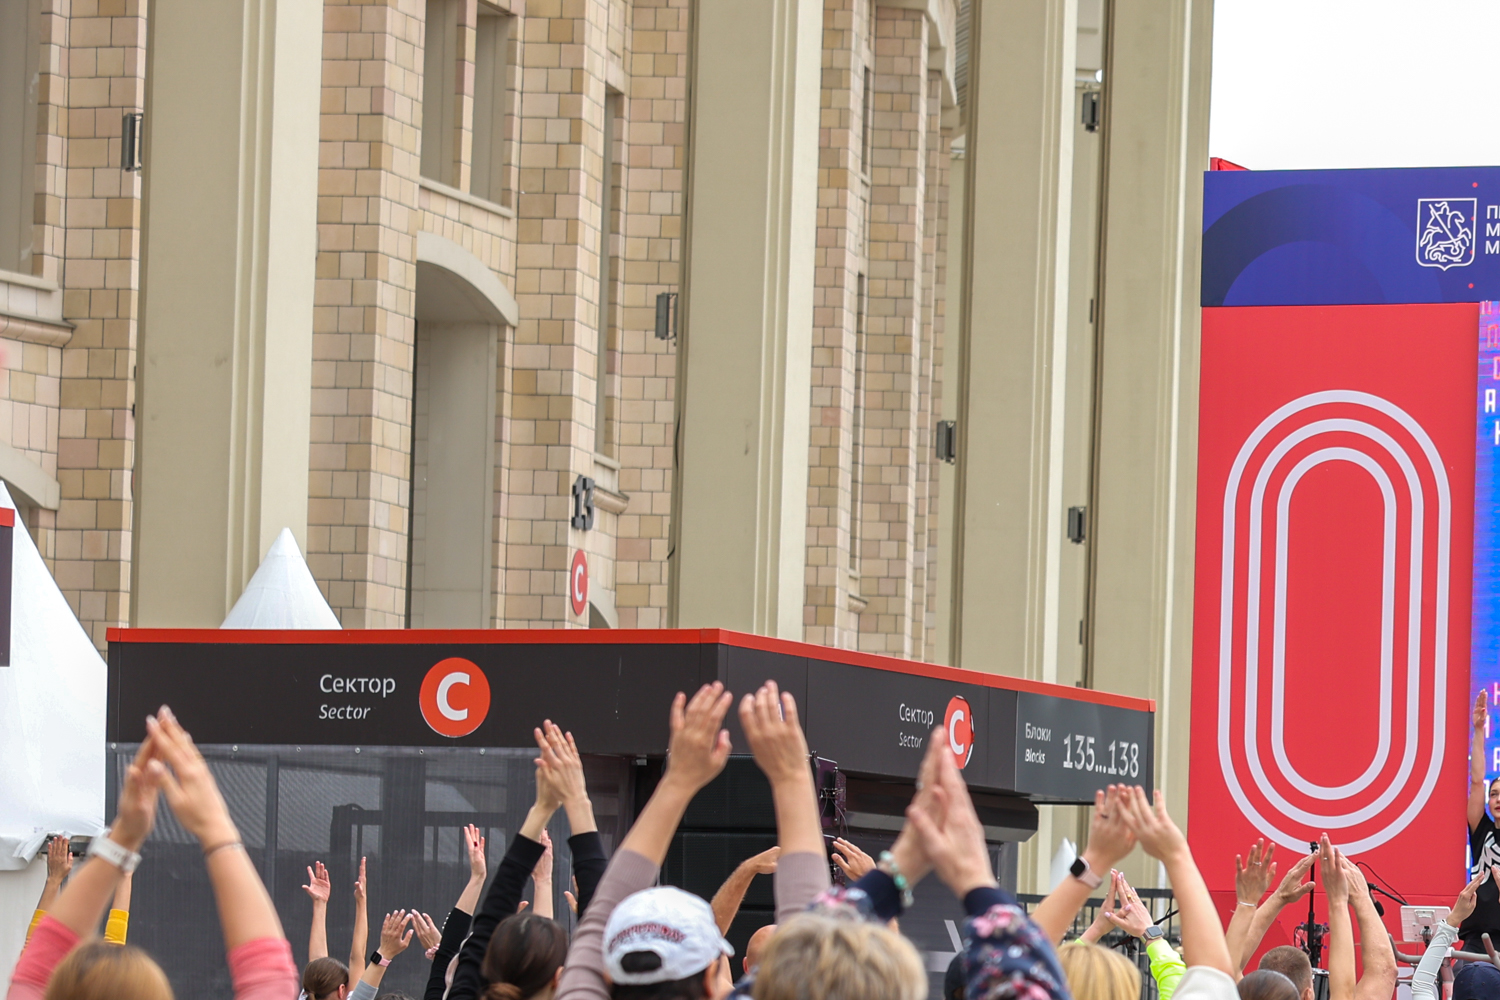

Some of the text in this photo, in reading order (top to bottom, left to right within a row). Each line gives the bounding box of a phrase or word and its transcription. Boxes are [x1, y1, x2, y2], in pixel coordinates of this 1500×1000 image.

[571, 474, 595, 531] 13
[319, 674, 396, 699] Сектор
[318, 704, 371, 720] Sector
[899, 703, 934, 729] Сектор
[898, 731, 923, 749] Sector
[1025, 722, 1052, 742] Блоки
[1024, 748, 1046, 764] Blocks
